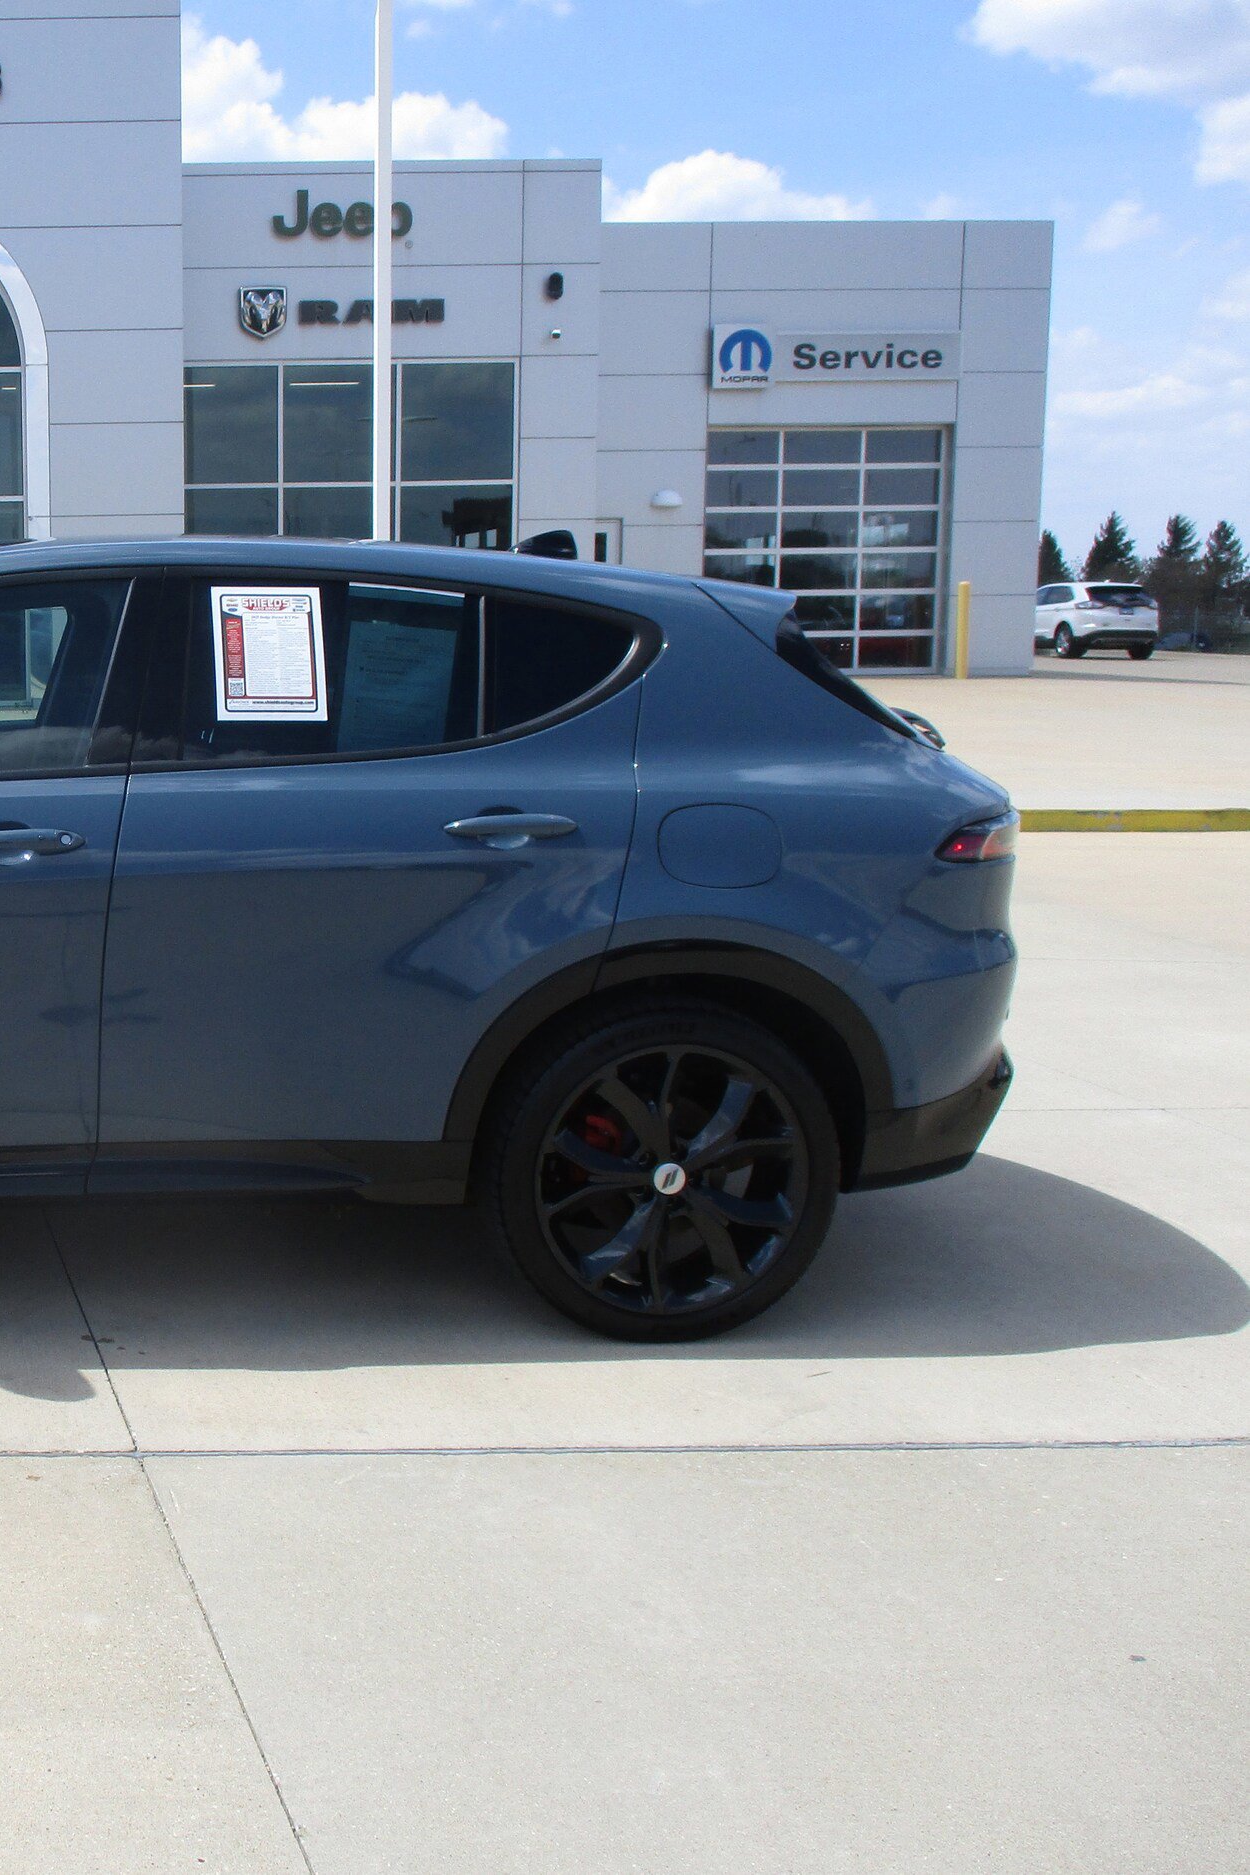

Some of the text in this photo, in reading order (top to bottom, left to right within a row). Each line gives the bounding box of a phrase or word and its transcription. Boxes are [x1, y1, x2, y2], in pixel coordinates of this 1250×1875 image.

[298, 298, 445, 325] RAM
[793, 343, 943, 370] Service
[720, 375, 768, 383] MOPAR
